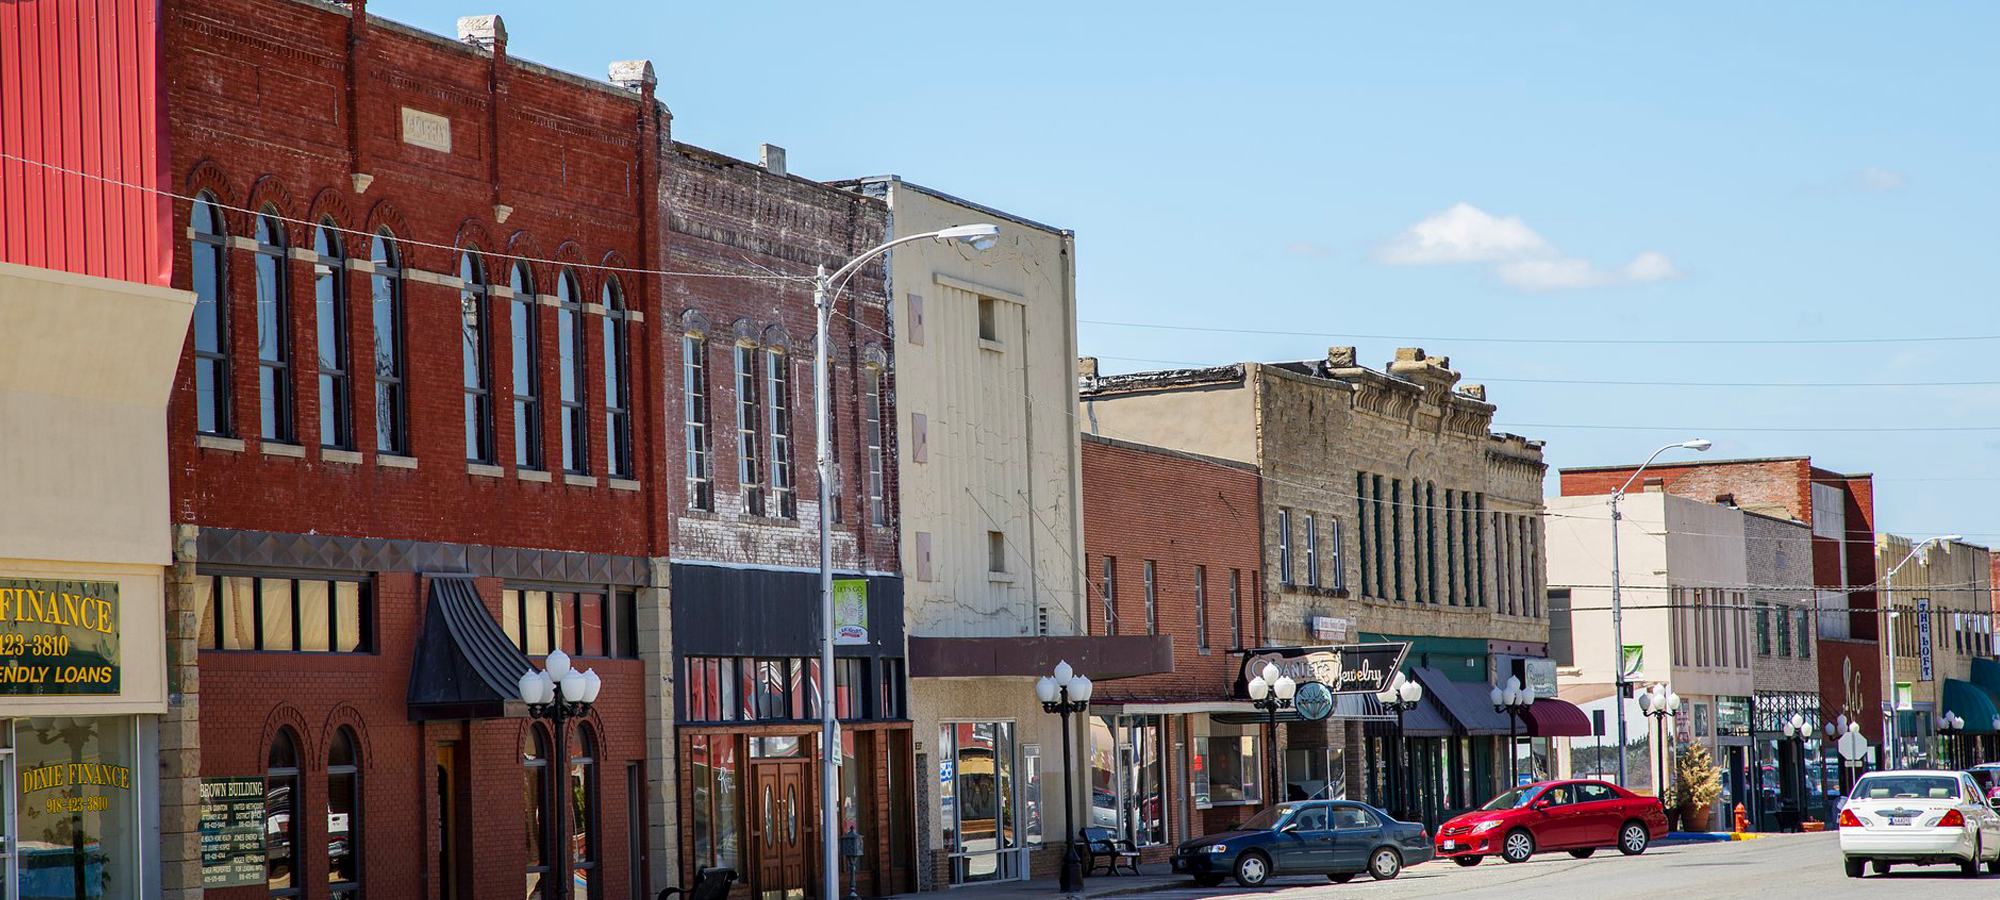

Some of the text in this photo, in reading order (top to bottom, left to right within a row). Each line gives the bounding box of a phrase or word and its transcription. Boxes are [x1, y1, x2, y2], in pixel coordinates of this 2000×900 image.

[0, 588, 112, 634] FINANCE
[1922, 636, 1930, 676] LOFT
[55, 666, 113, 684] LOANS
[1336, 658, 1384, 691] Jewelry
[23, 763, 131, 795] DIXIE FINANCE
[200, 781, 263, 798] BROWN BUILDING
[46, 795, 109, 815] 918-423-3810
